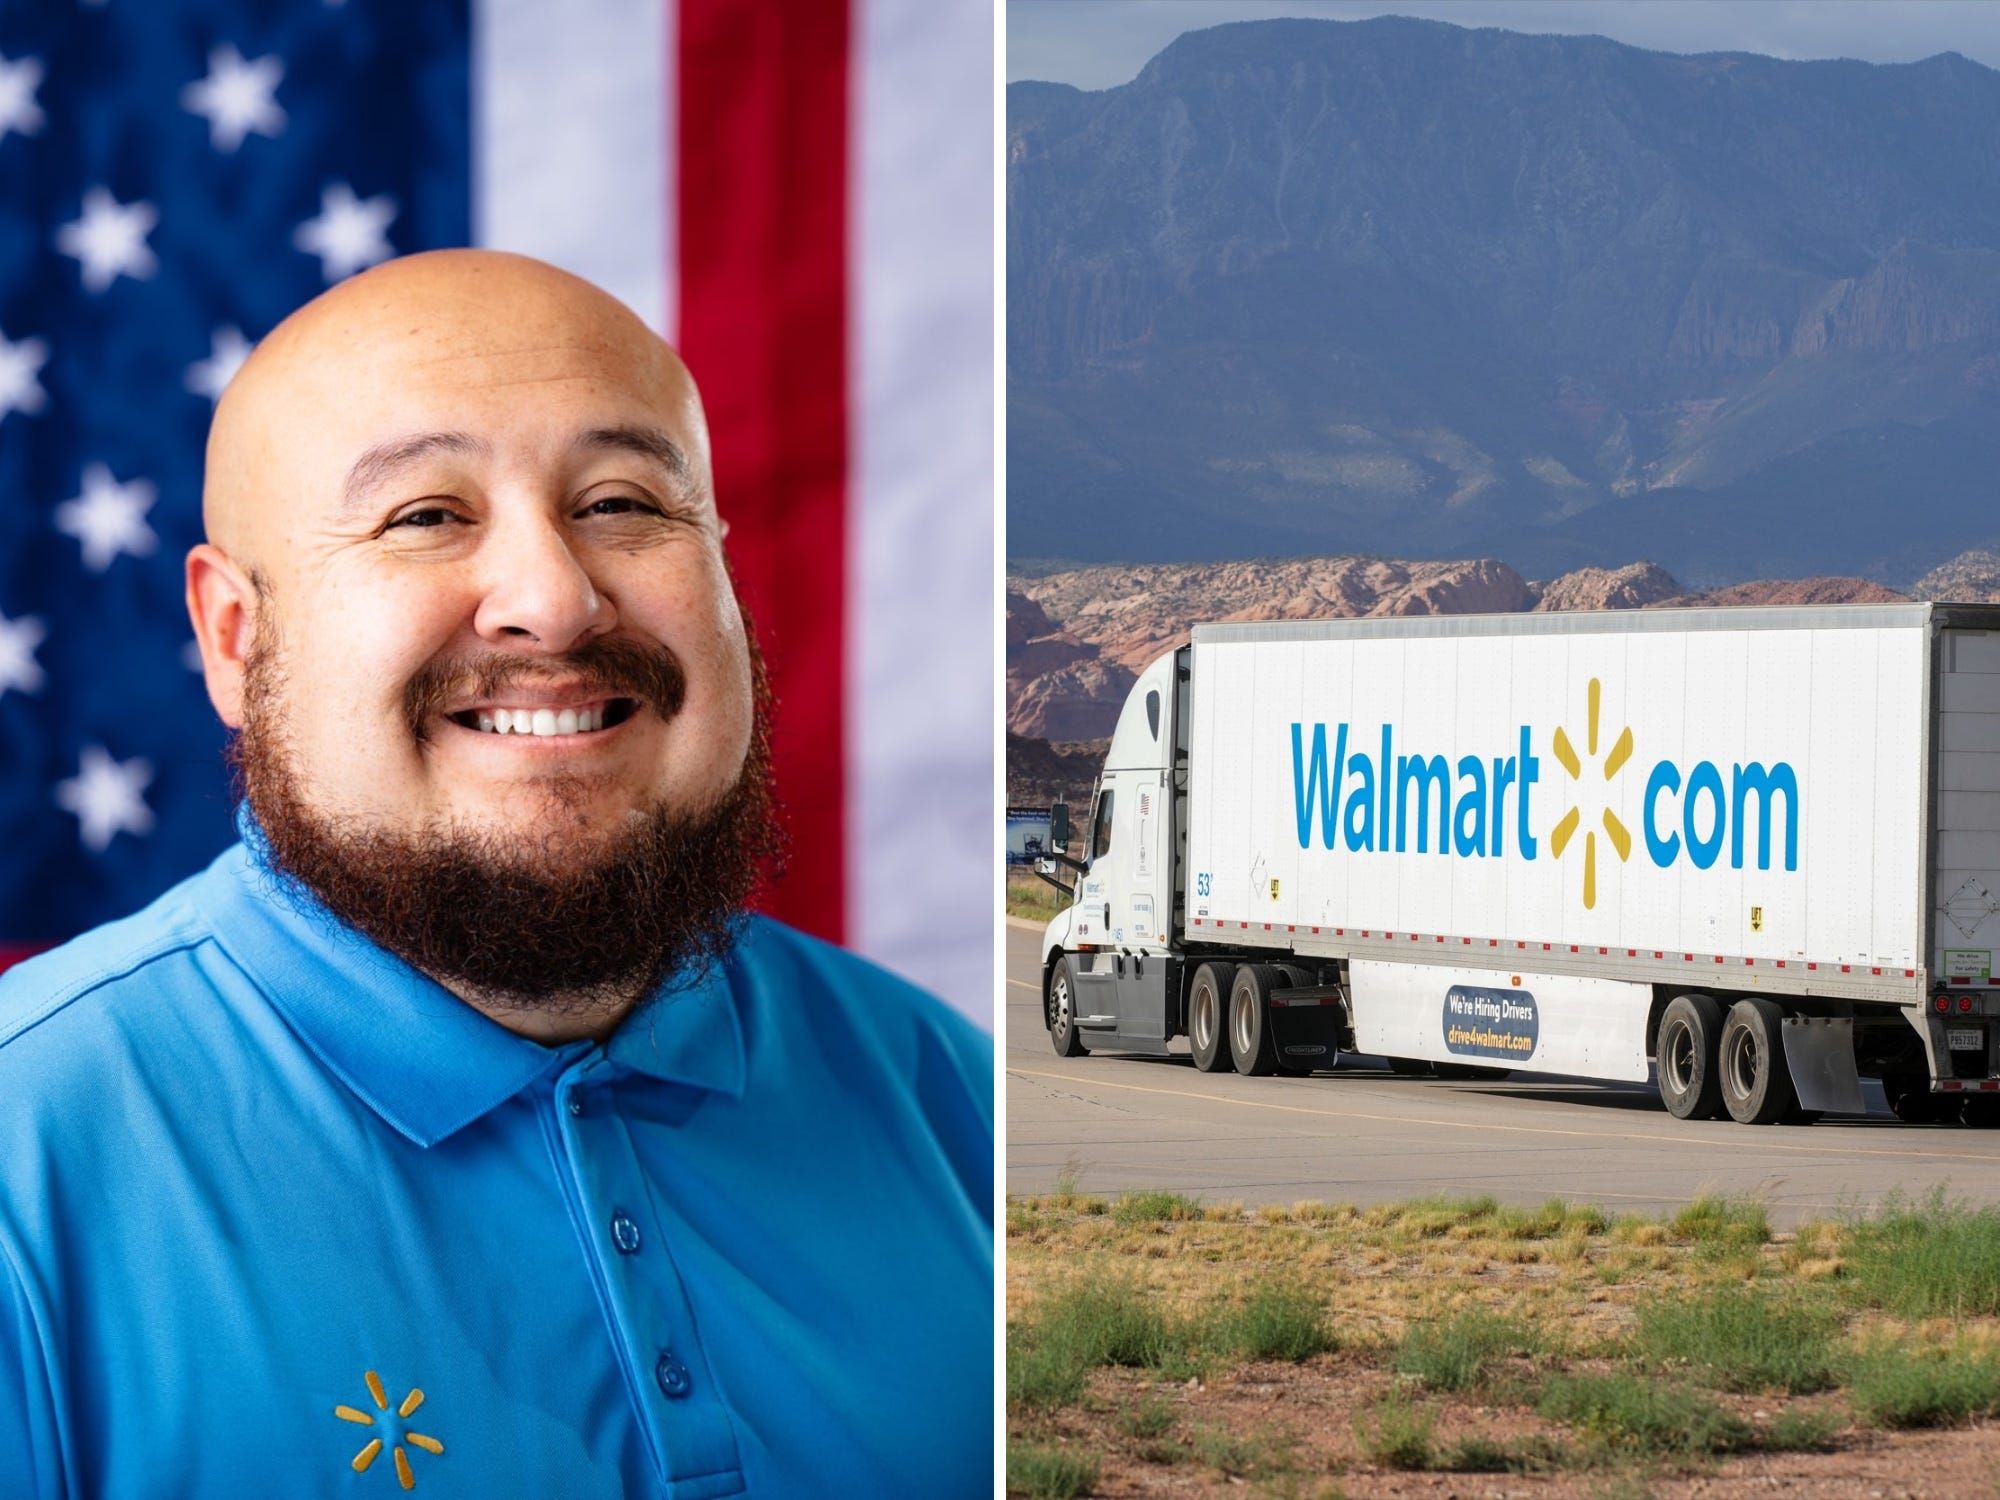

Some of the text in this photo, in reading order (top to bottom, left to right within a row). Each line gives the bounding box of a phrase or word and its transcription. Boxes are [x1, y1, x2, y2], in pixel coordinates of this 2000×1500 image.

[1291, 722, 1539, 861] Walmart
[1450, 995, 1533, 1023] We're Hiring Drivers
[1448, 1024, 1532, 1051] drive4walmart.com
